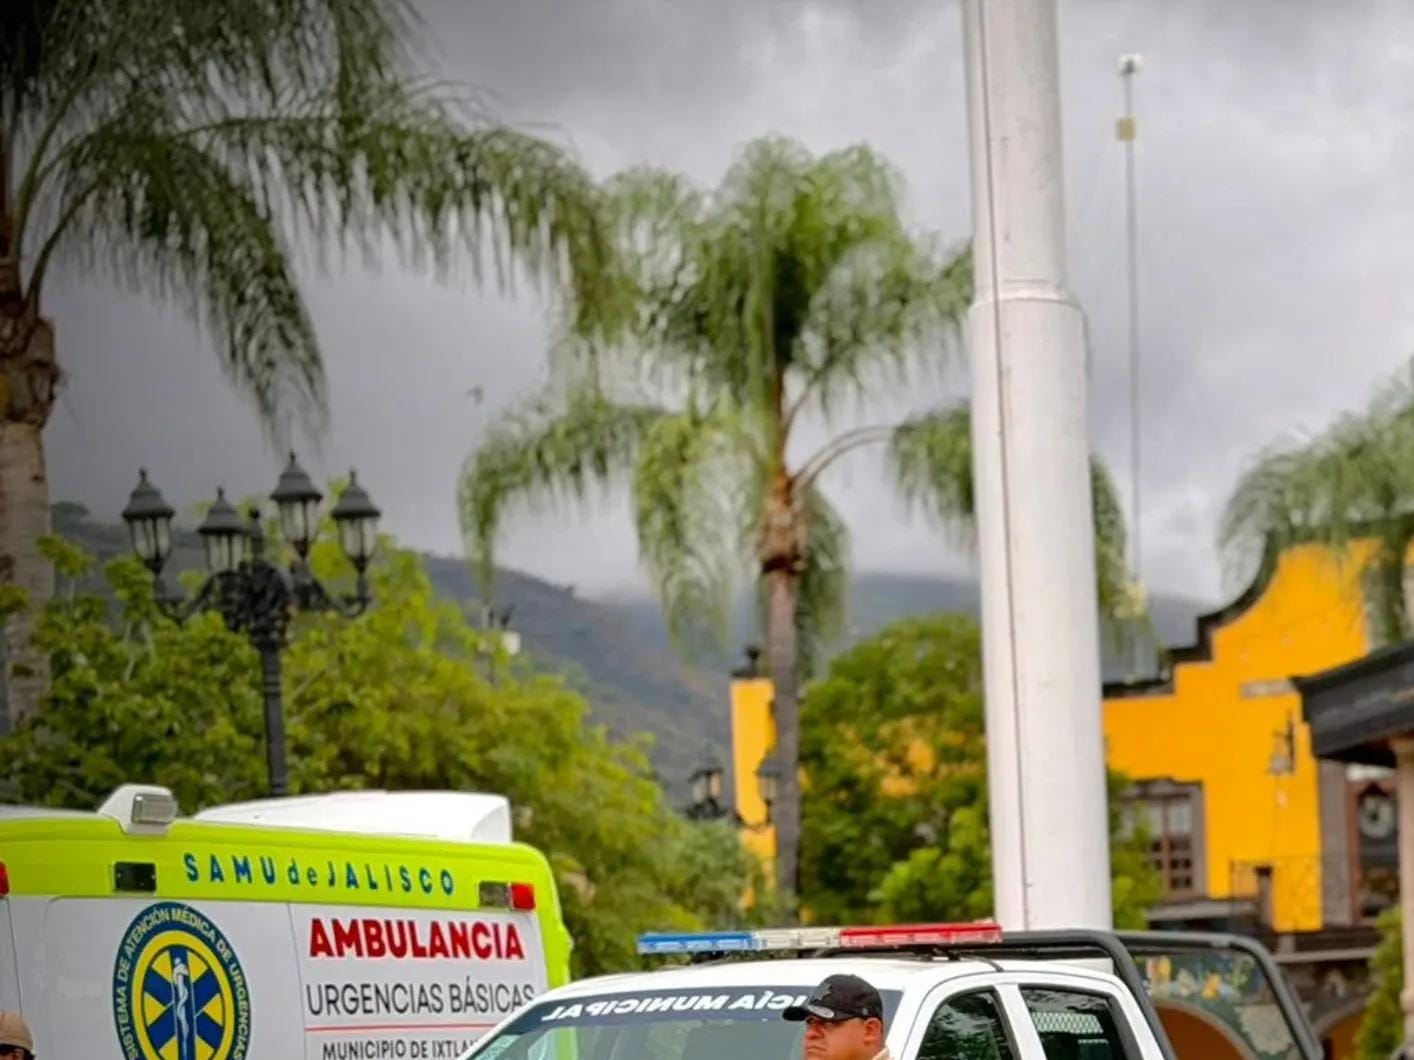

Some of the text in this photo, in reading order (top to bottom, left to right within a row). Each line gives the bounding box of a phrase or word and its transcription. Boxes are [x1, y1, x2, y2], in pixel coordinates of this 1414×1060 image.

[183, 852, 276, 885] SAMU
[327, 860, 454, 896] JALISCO
[126, 906, 170, 958] ATENCIÓN
[172, 905, 216, 942] MÉDICA
[309, 918, 525, 960] AMBULANCIA
[118, 958, 130, 982] DE
[216, 941, 231, 962] DE
[306, 975, 535, 1016] URGENCIAS BÁSICAS
[116, 987, 139, 1060] SISTEMA
[410, 1041, 429, 1059] DE
